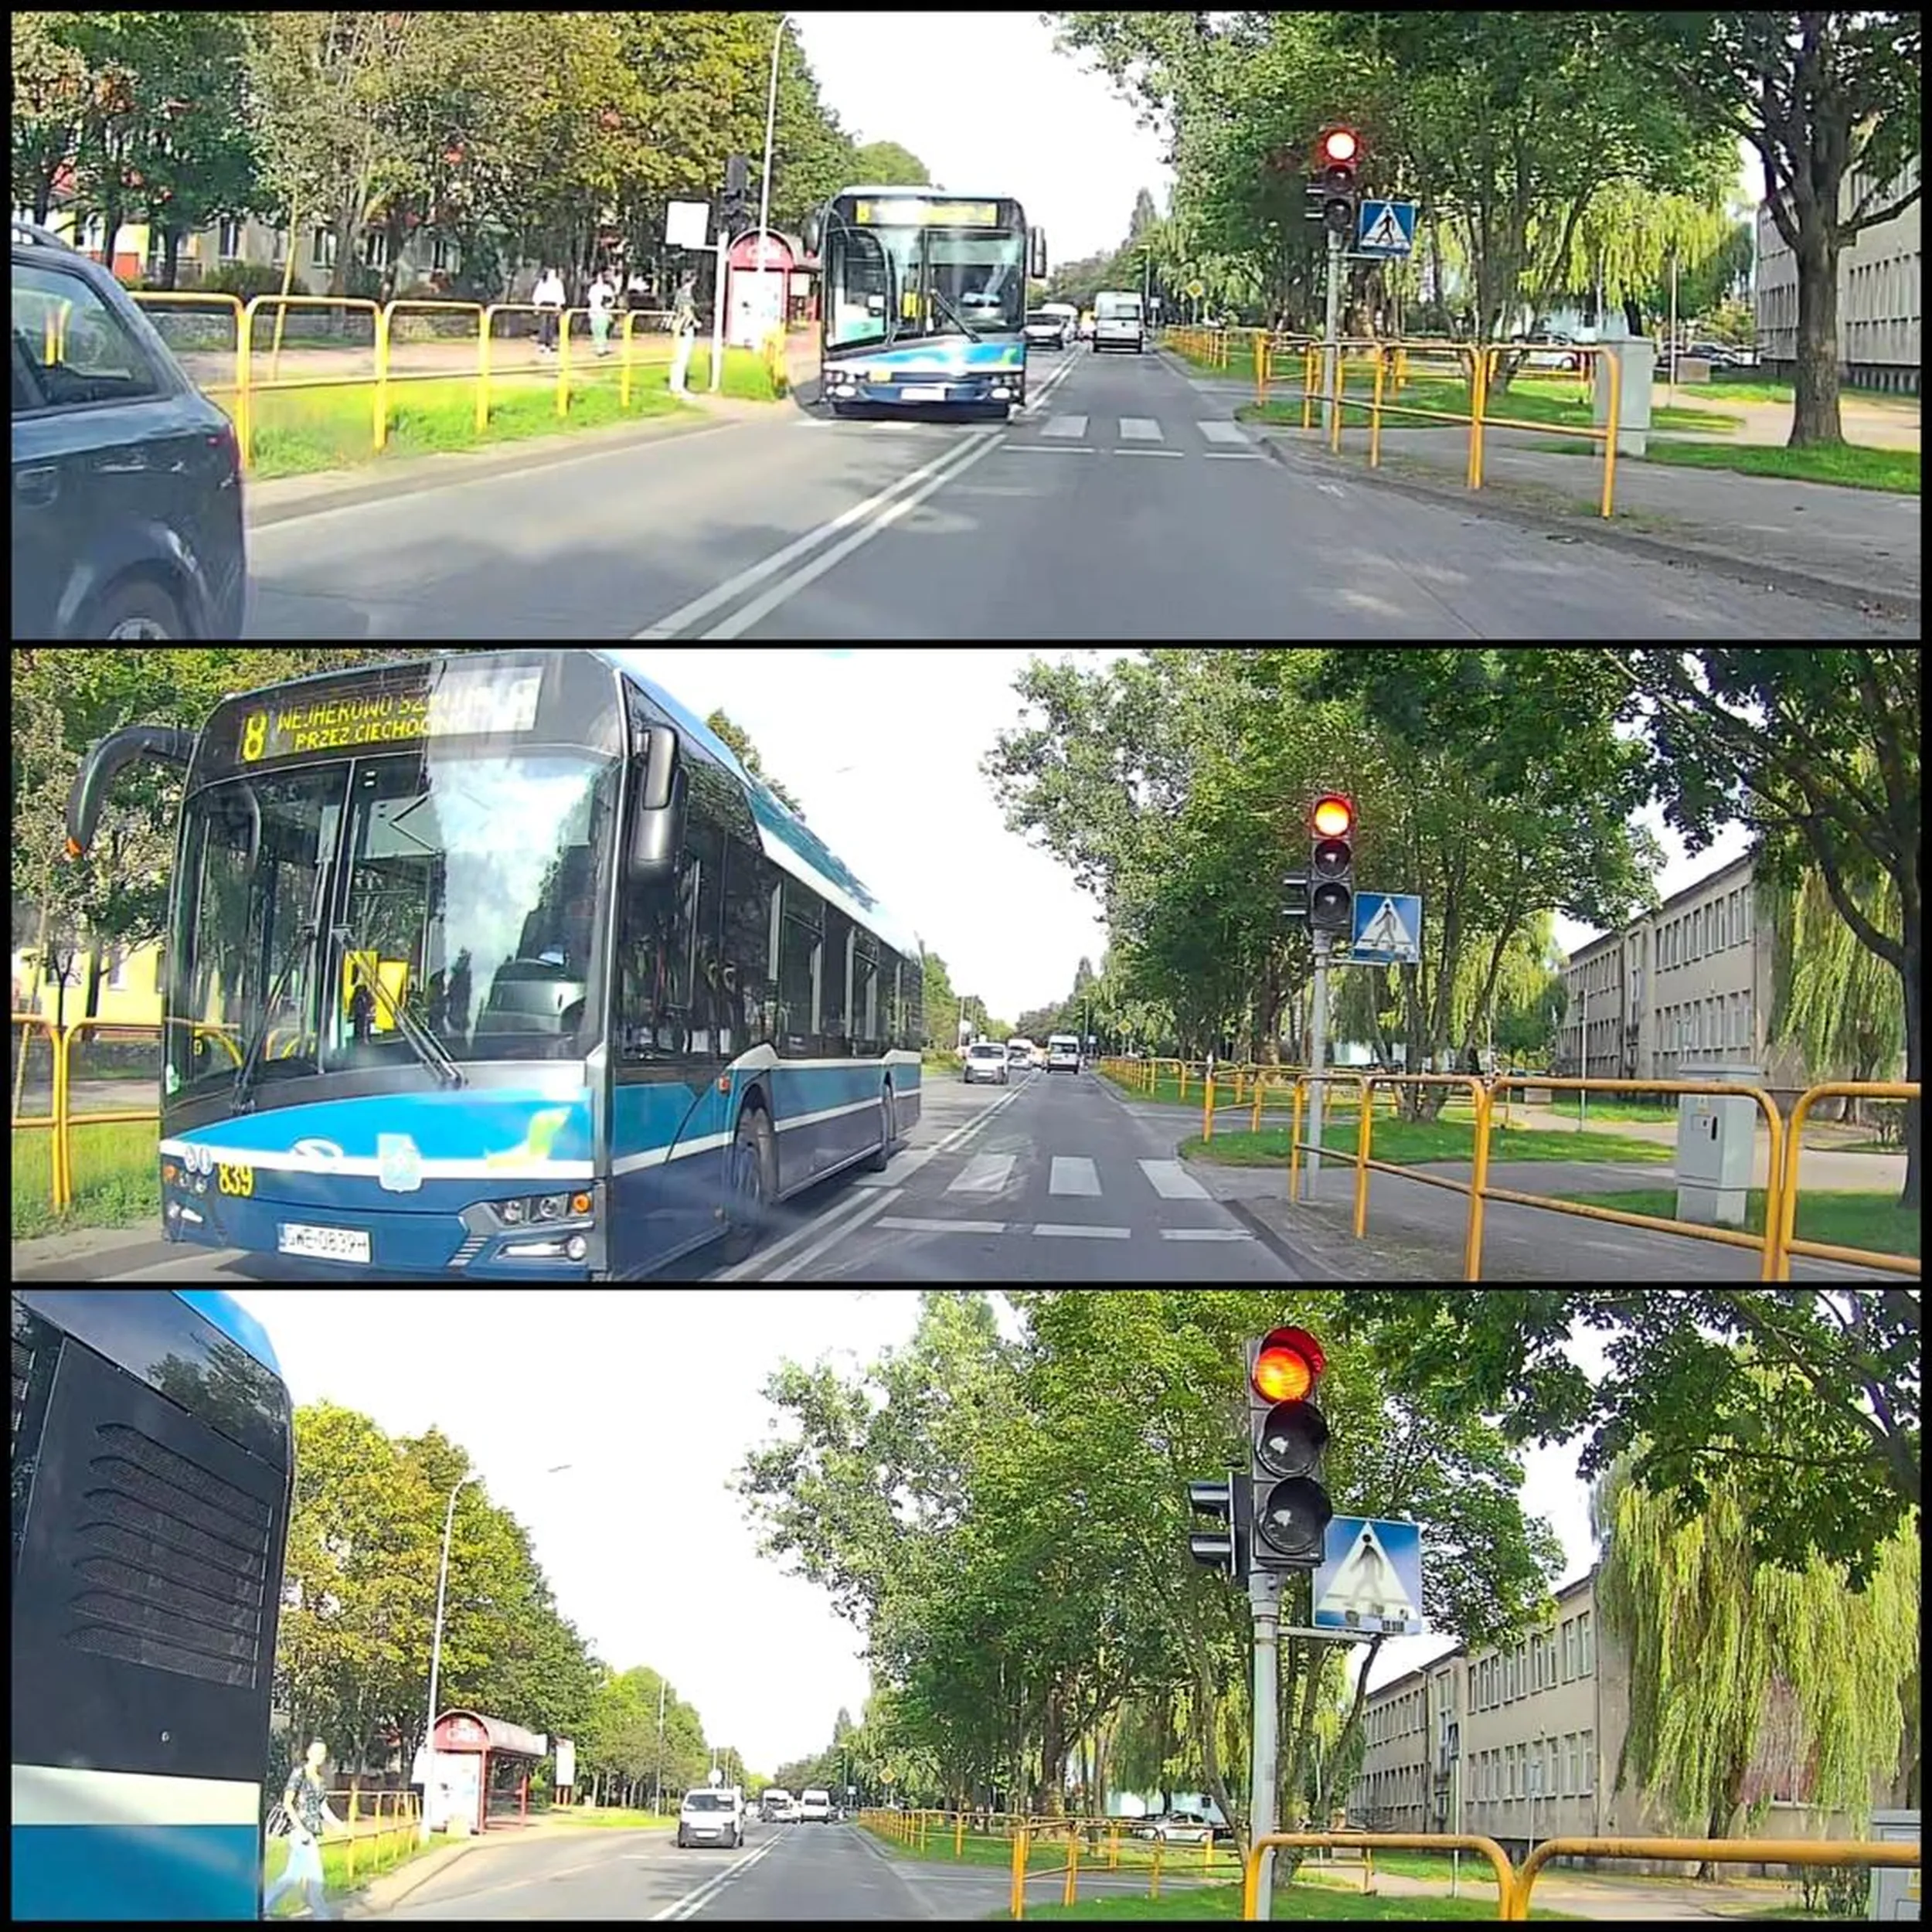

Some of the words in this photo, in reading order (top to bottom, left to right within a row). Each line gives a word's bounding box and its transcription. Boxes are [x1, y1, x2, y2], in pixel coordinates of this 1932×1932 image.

[276, 695, 393, 733] WEJHEROWO
[242, 709, 267, 762] 8
[294, 726, 353, 751] PRZEZ
[219, 1162, 253, 1196] 839
